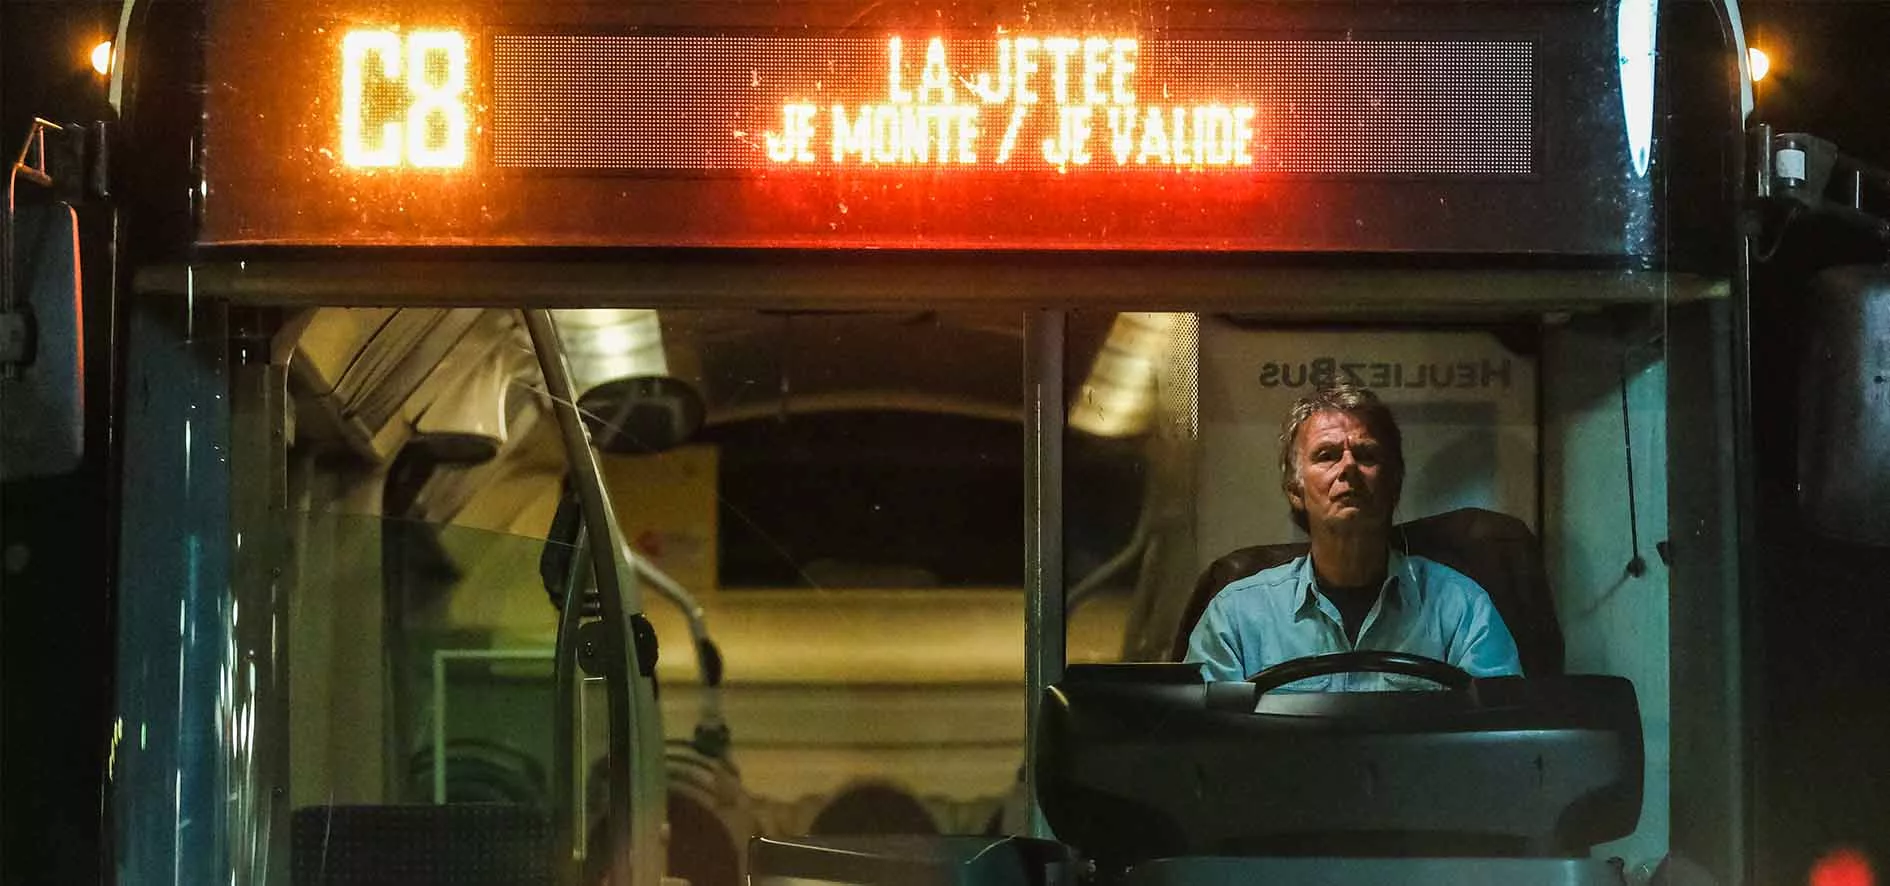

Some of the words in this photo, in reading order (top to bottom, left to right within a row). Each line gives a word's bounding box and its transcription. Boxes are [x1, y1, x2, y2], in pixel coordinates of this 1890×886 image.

[341, 31, 466, 168] C8
[888, 36, 954, 104] LA
[979, 36, 1138, 104] JETEE
[767, 104, 816, 164] JE
[833, 104, 977, 164] MONTE
[995, 104, 1026, 164] /
[1042, 104, 1095, 164] JE
[1108, 104, 1254, 164] VALIDE
